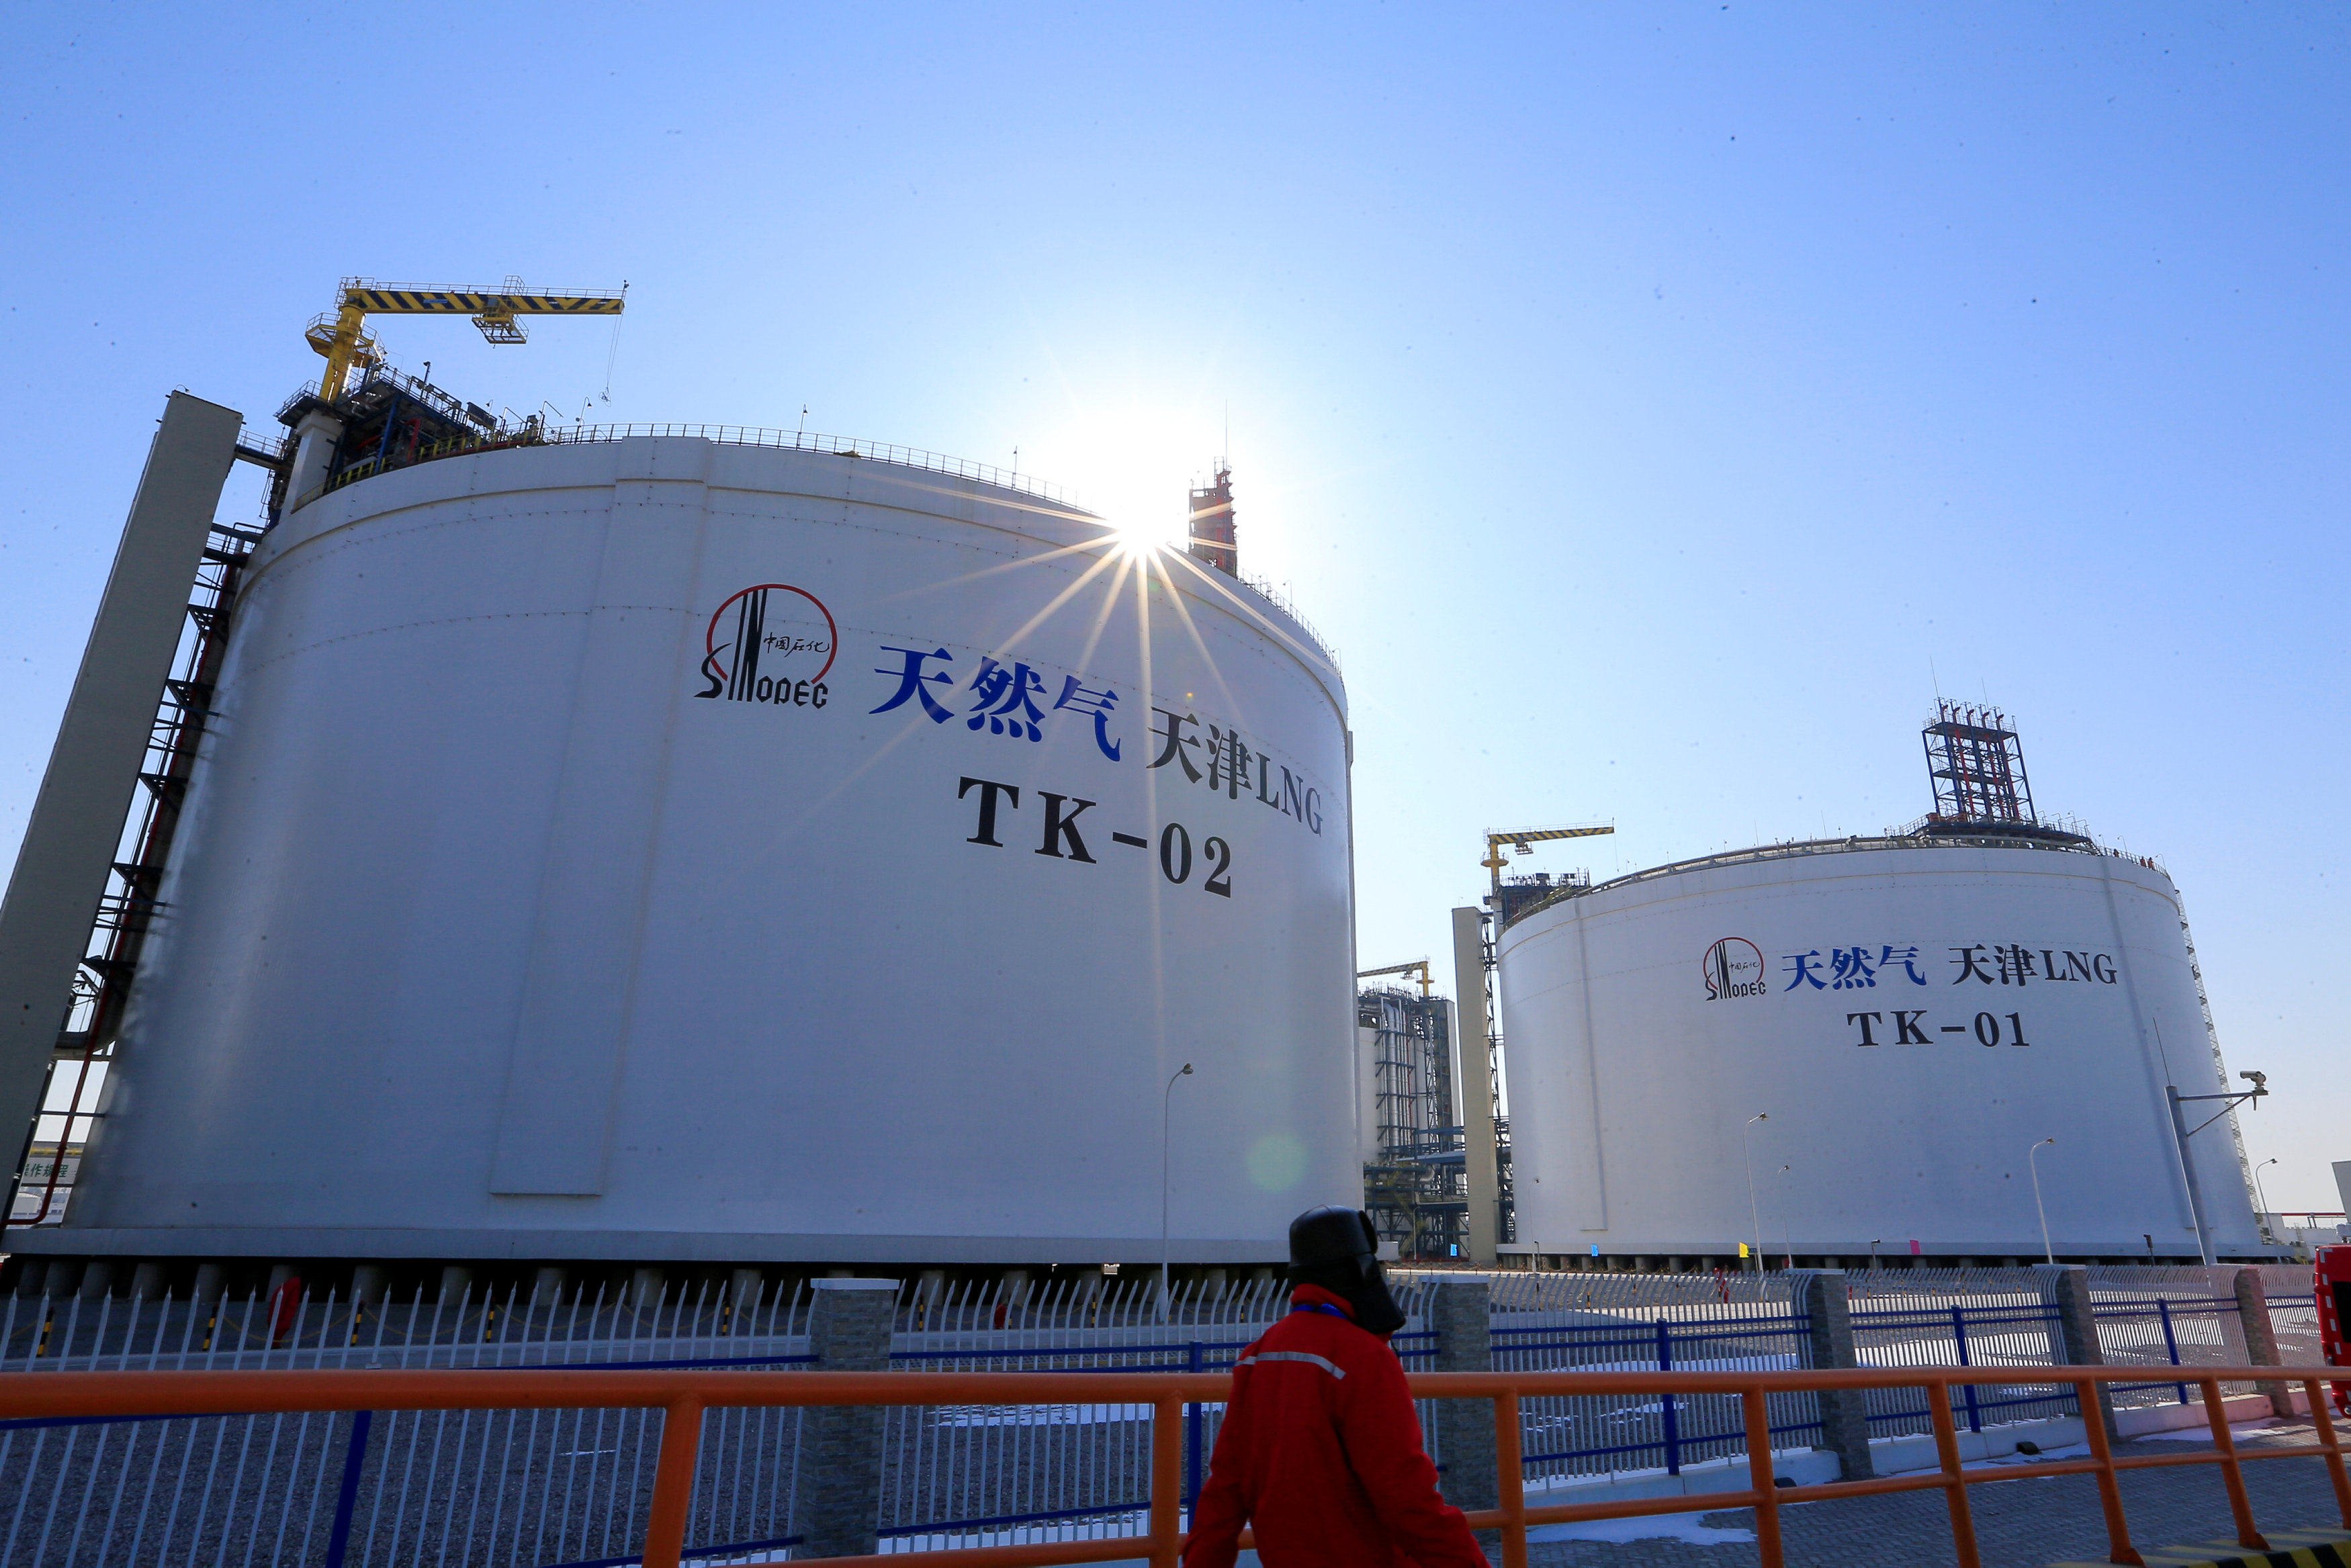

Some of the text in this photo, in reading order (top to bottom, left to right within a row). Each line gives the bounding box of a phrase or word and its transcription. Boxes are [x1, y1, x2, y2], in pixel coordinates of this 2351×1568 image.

[693, 588, 829, 709] SINOPEC
[763, 631, 830, 658] 中国石化
[868, 645, 1323, 837] 天然气 天津LNG
[958, 776, 1232, 898] TK-02
[1705, 941, 1766, 1001] SINOPEC
[1782, 943, 2117, 993] 天然气 天津LNG
[1847, 1010, 2030, 1048] TK-01
